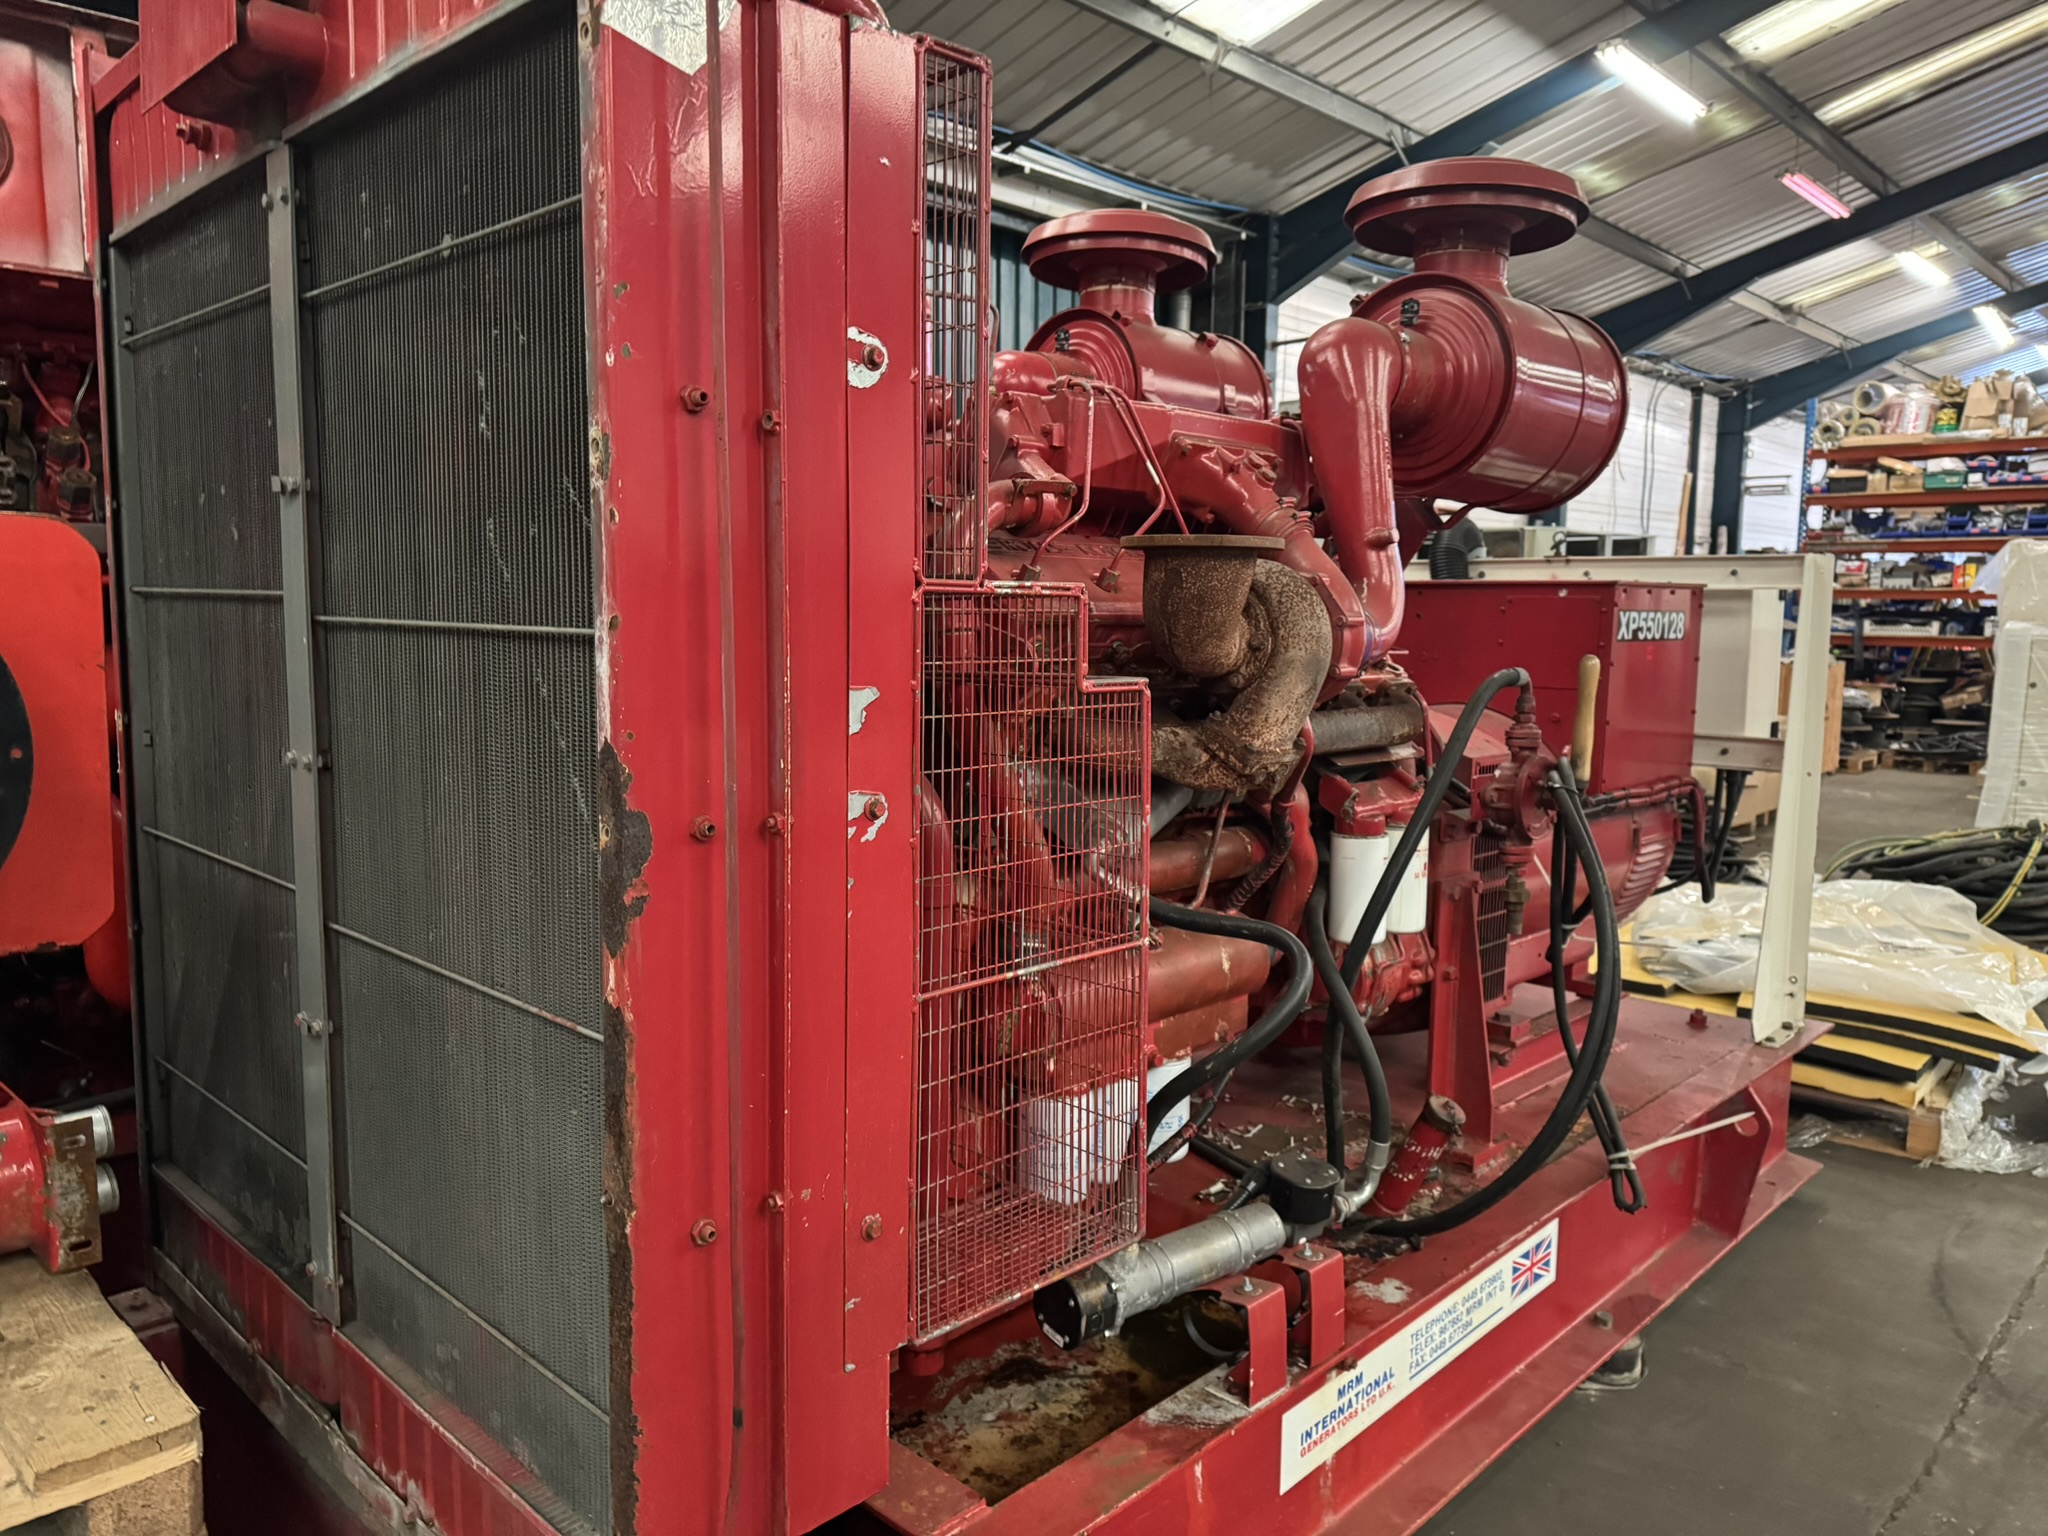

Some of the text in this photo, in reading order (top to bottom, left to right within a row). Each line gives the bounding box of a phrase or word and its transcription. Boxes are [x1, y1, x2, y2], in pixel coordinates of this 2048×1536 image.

[1617, 611, 1685, 640] XP550128
[1465, 1296, 1484, 1318] MRM
[1485, 1285, 1499, 1303] INT
[1499, 1280, 1505, 1292] G
[1337, 1371, 1364, 1402] MRM
[1300, 1367, 1395, 1447] INTERNATIONAL
[1300, 1382, 1395, 1458] GENERATORS LTD U.K.
